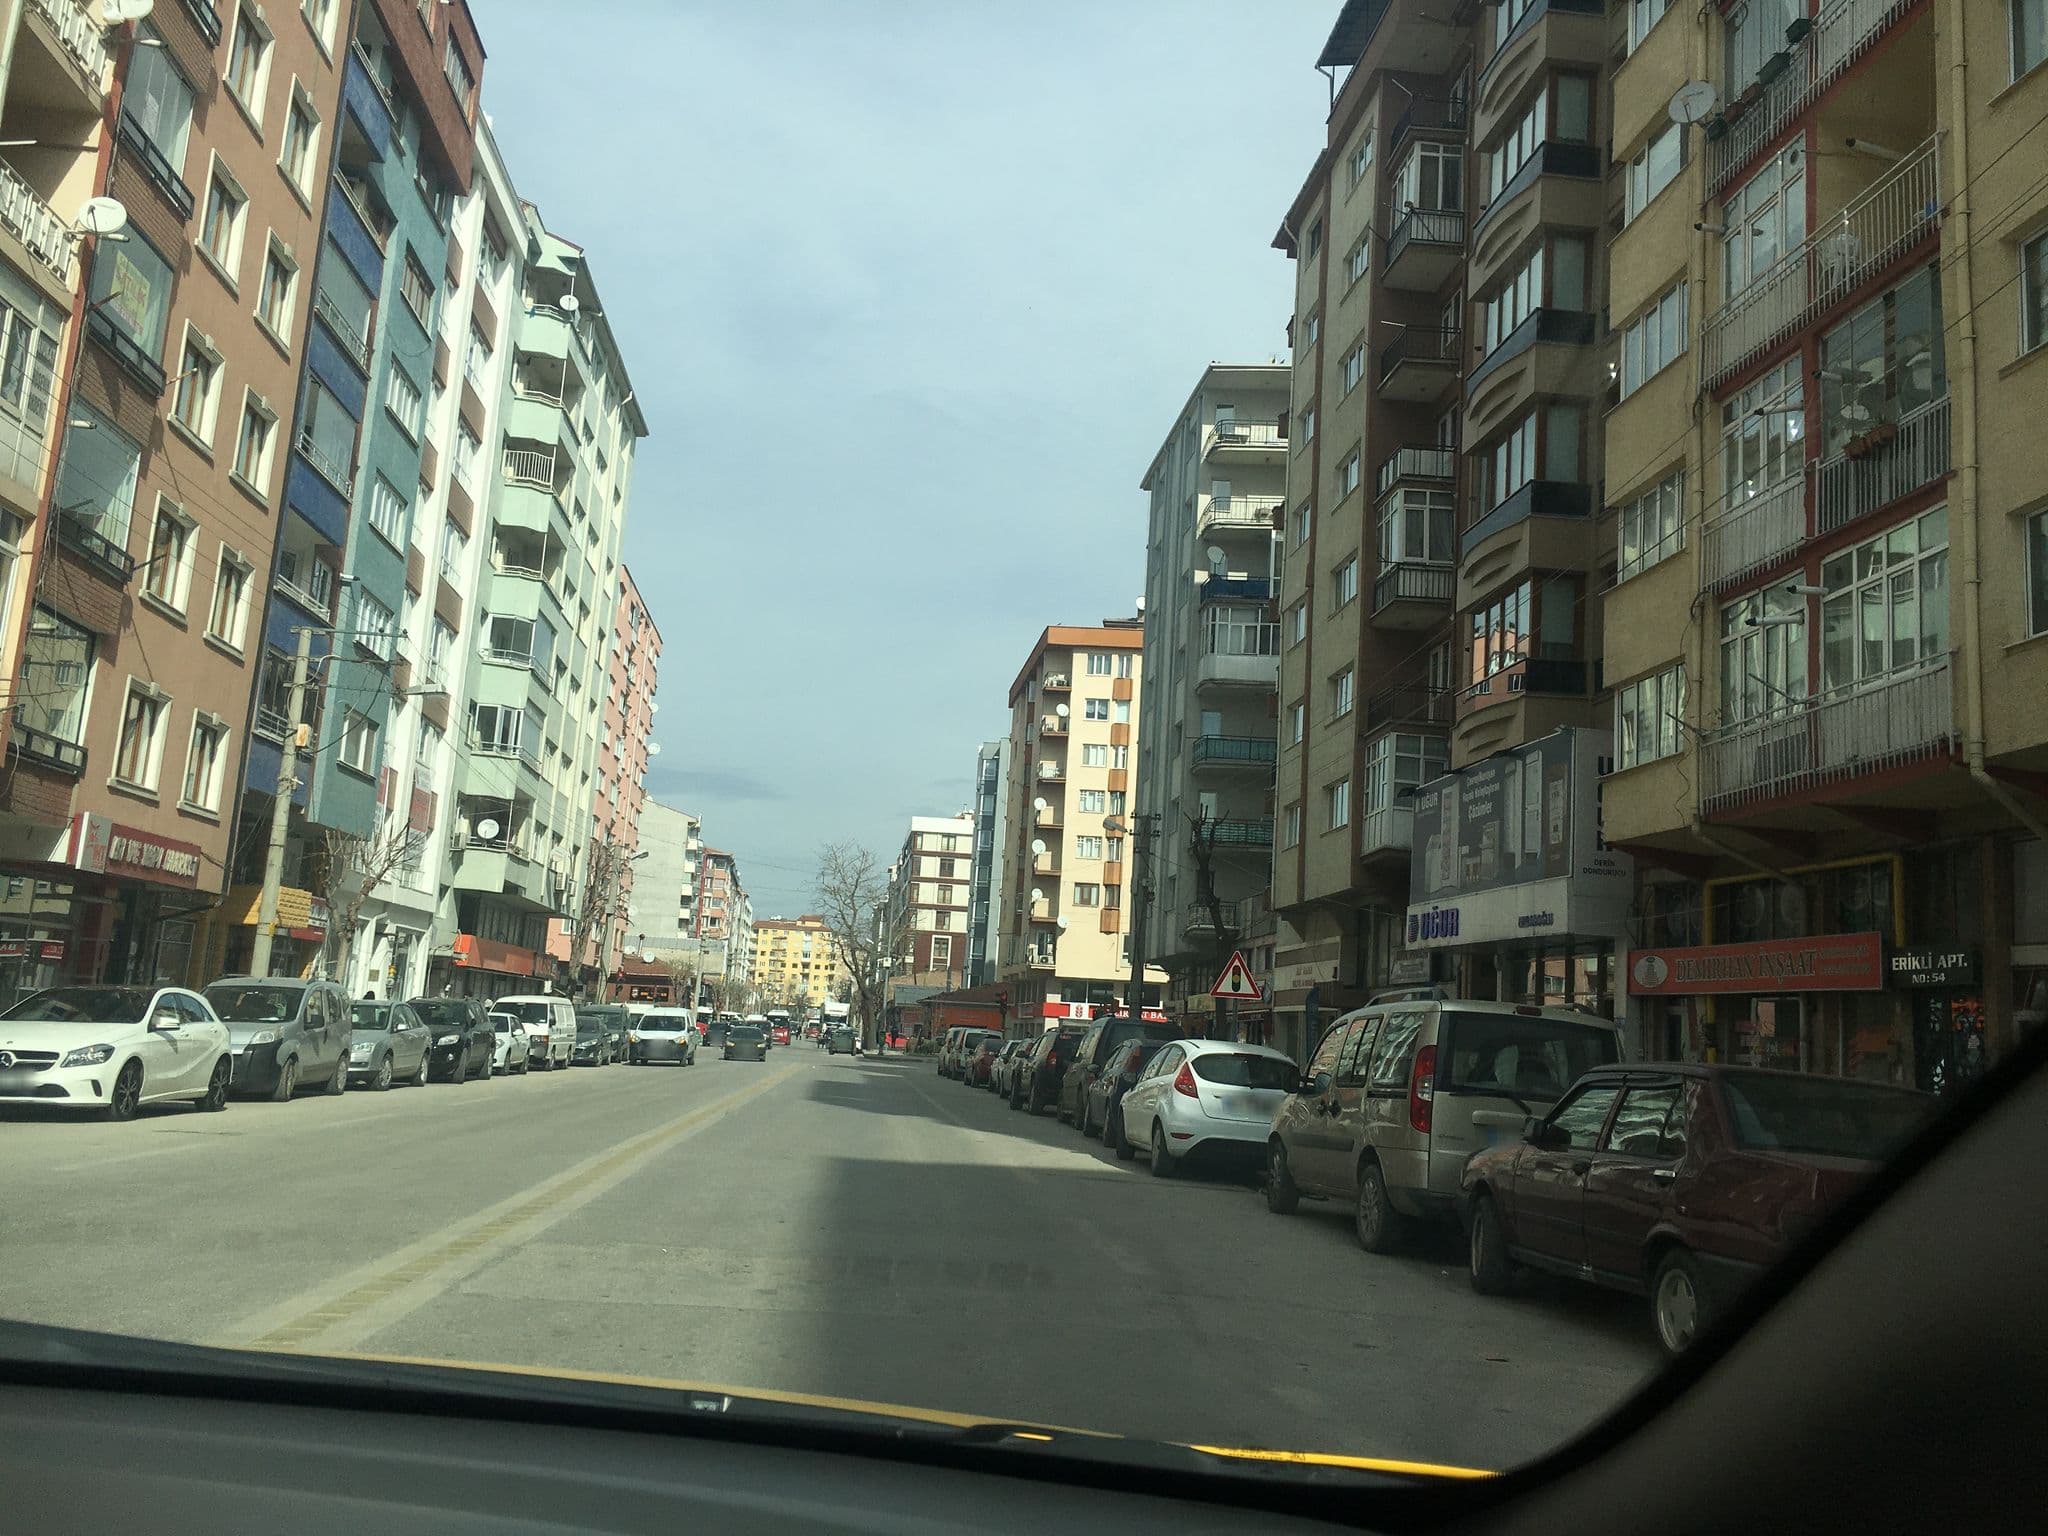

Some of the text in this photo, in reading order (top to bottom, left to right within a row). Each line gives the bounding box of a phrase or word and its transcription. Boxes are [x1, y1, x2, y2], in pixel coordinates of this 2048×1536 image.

[1420, 905, 1459, 940] UĞUR
[1758, 946, 1817, 985] İNŞAAT
[1892, 952, 1933, 971] ERİKLİ
[1937, 953, 1968, 969] APT.
